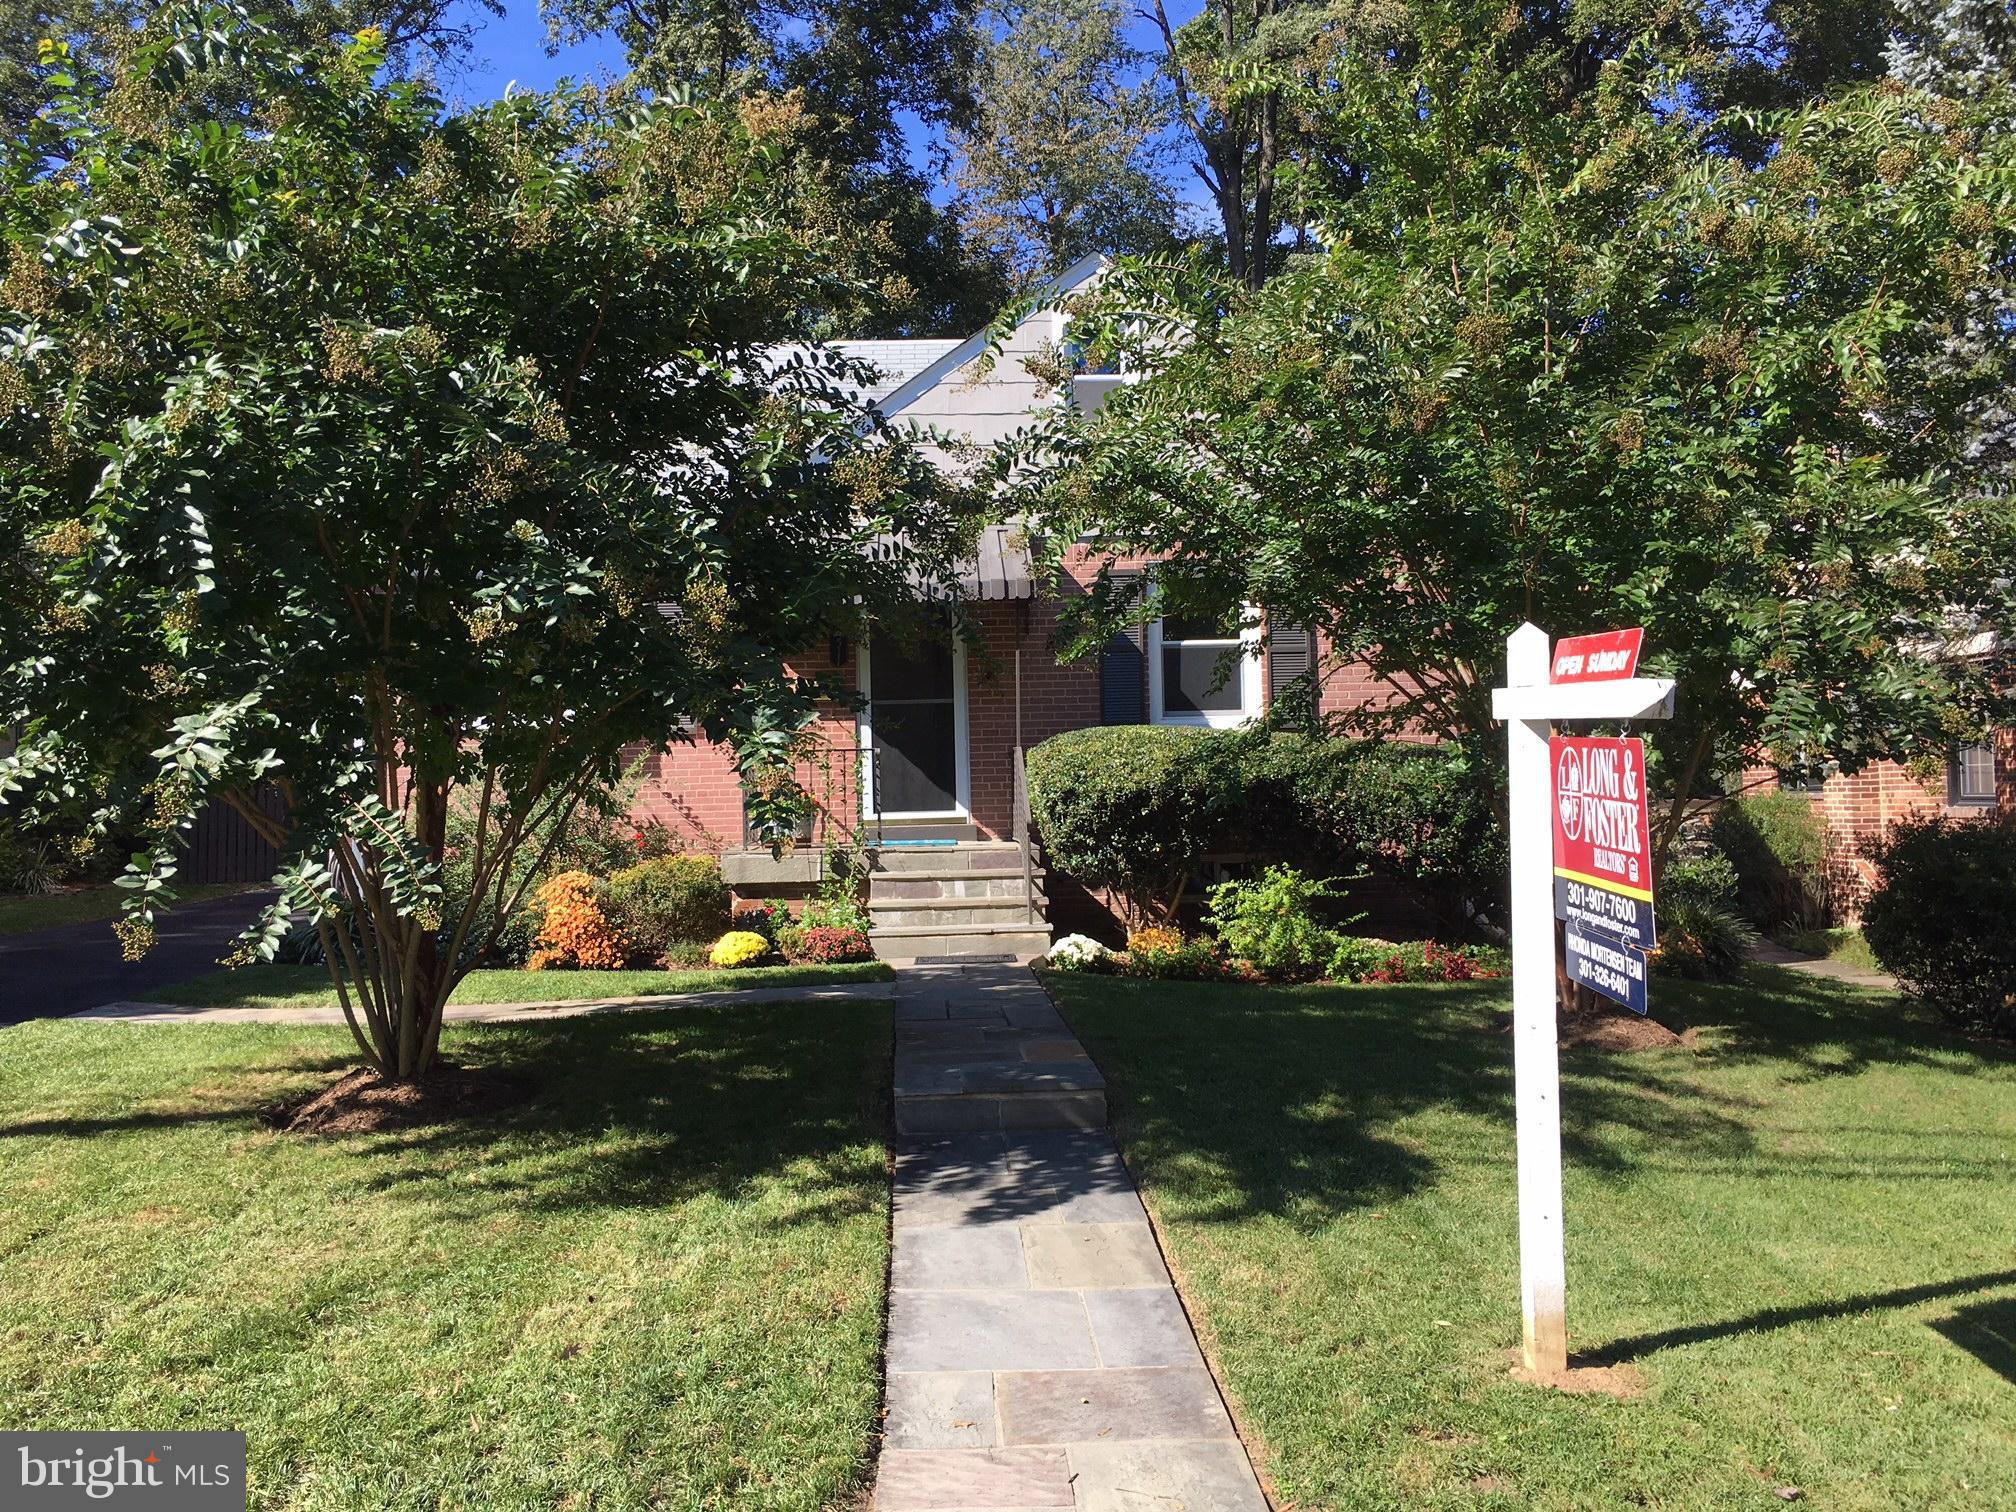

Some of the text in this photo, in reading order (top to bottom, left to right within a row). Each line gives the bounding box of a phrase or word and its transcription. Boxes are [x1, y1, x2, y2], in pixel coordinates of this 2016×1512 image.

[1555, 648, 1632, 676] OPEN SUNDAY
[1581, 747, 1638, 801] LONG &
[1583, 796, 1641, 854] FOSTER
[1566, 905, 1640, 940] www.longandfoster.com
[1567, 881, 1637, 924] 301-907-7600
[1567, 932, 1643, 981] RHONDA MORTENSEN TEAM
[1578, 957, 1630, 1000] 301-326-6401
